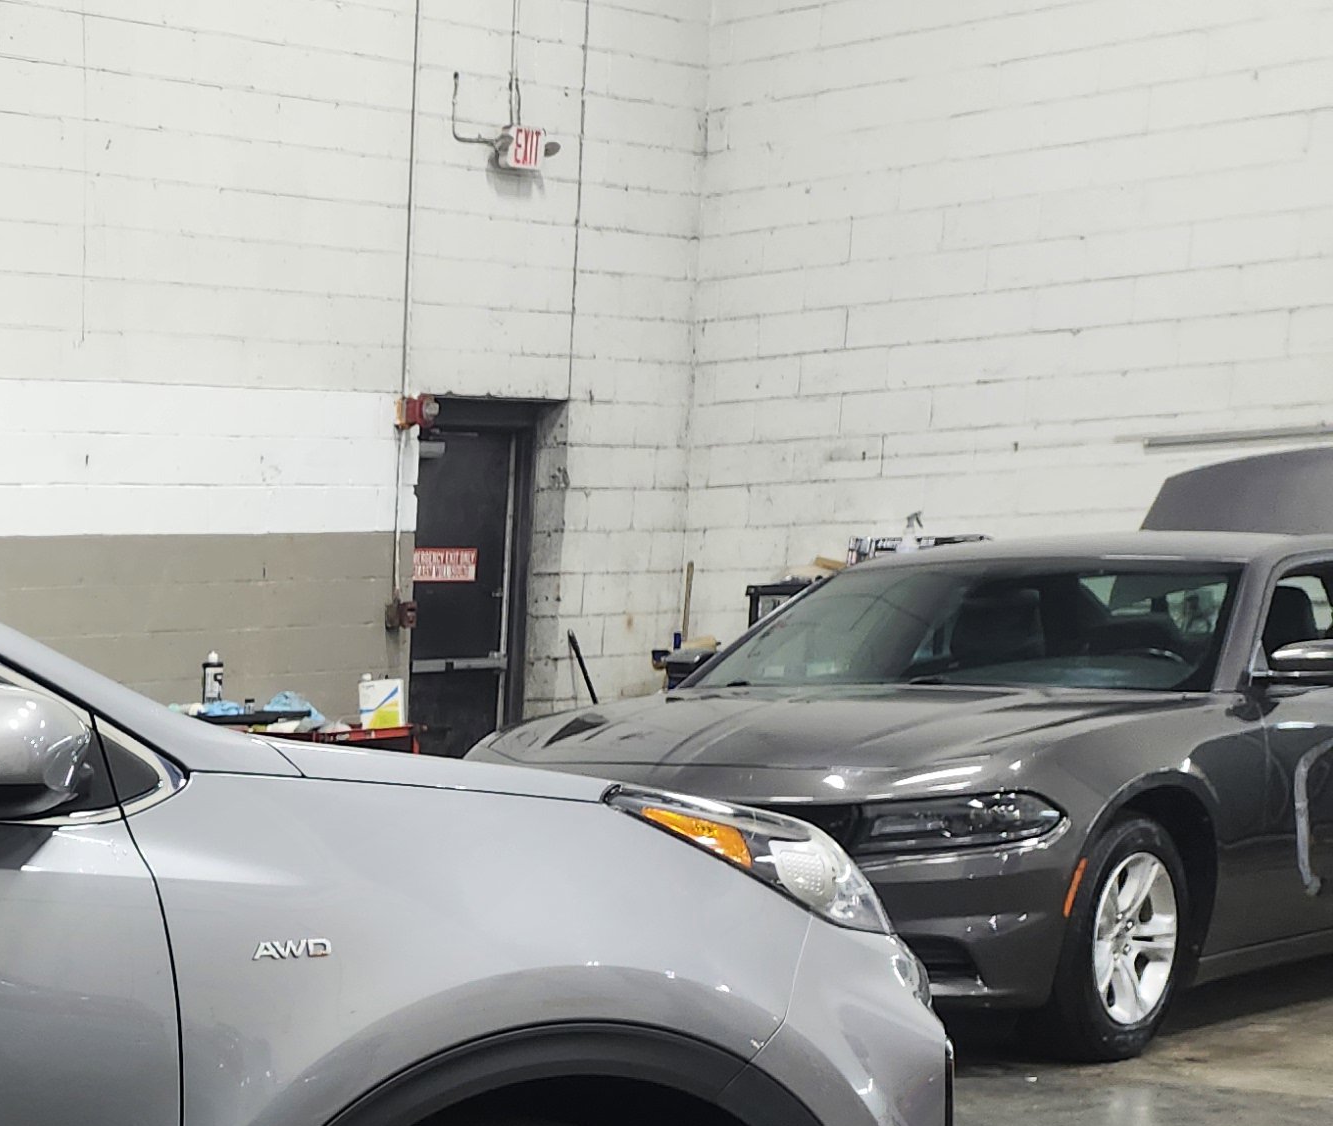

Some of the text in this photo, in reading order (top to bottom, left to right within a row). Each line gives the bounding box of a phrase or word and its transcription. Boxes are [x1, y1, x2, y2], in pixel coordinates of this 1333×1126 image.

[514, 127, 542, 166] EXIT
[445, 550, 459, 565] EXIT
[252, 938, 332, 960] AWD
